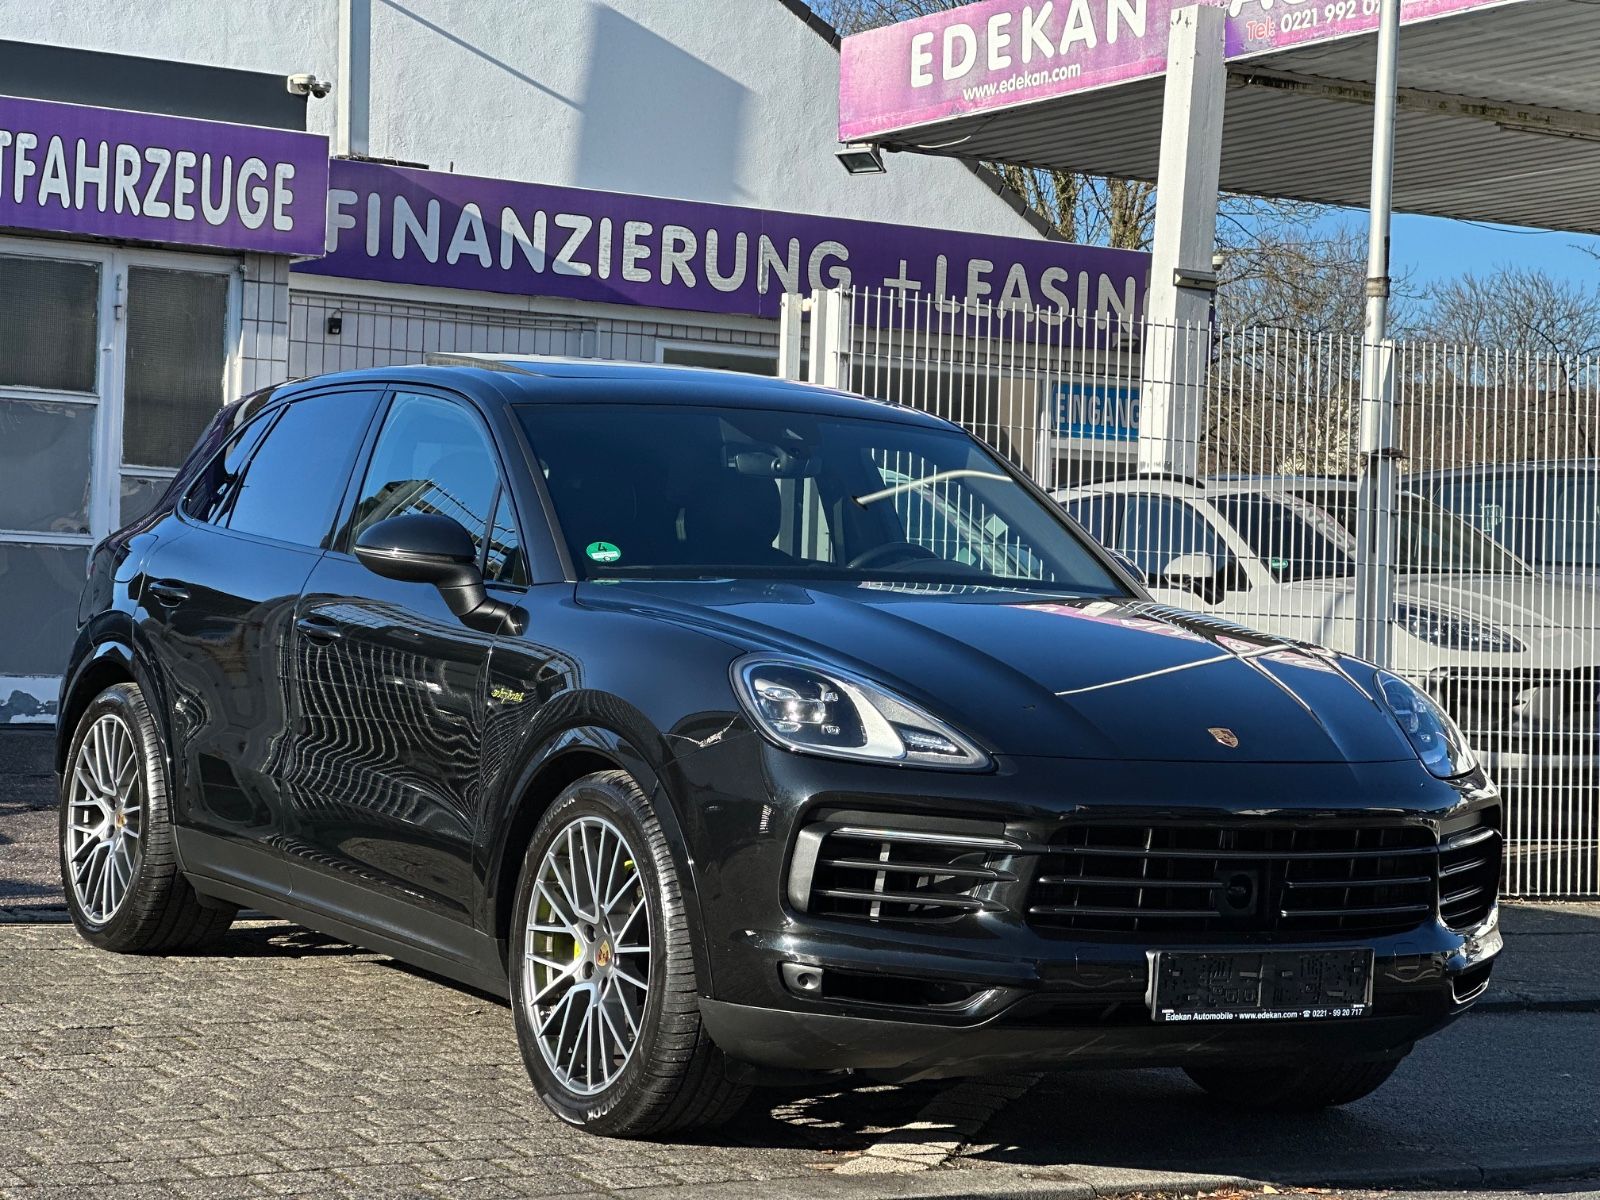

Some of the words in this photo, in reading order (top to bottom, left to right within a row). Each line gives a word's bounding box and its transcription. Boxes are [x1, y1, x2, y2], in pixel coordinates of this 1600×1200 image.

[1246, 16, 1275, 41] Tel:
[1281, 8, 1318, 32] 0221
[1325, 1, 1356, 24] 992
[910, 0, 1146, 88] EDEKAN
[962, 61, 1081, 101] www.edekan.com
[326, 188, 852, 294] FINANZIERUNG
[1165, 1012, 1191, 1021] Edekan
[1193, 1011, 1233, 1020] Automobile
[1239, 1011, 1298, 1020] www.edekan.com
[1312, 1009, 1327, 1018] 0221
[1342, 1008, 1350, 1016] 20
[1351, 1008, 1363, 1016] 717
